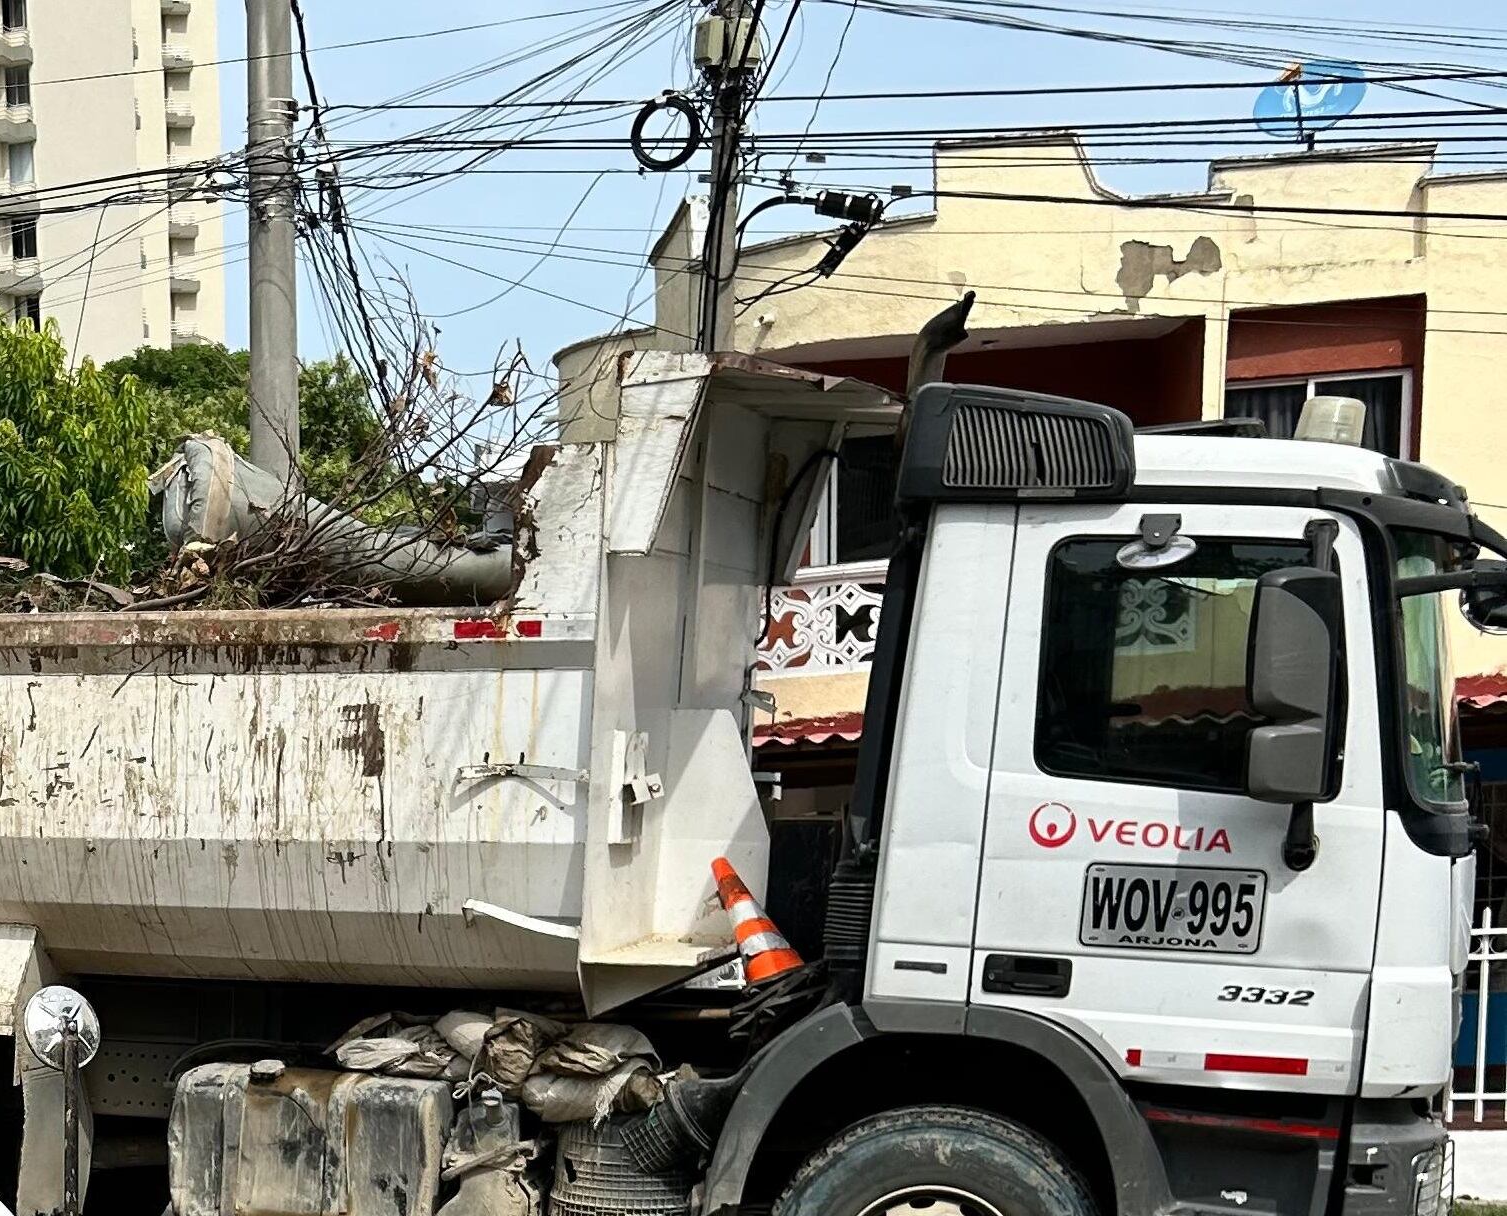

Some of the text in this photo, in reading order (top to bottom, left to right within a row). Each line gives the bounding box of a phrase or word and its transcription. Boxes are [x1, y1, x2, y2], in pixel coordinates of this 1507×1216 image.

[1087, 817, 1232, 853] VEOLIA
[1119, 935, 1217, 949] ARJONA
[1217, 985, 1315, 1006] 3332
